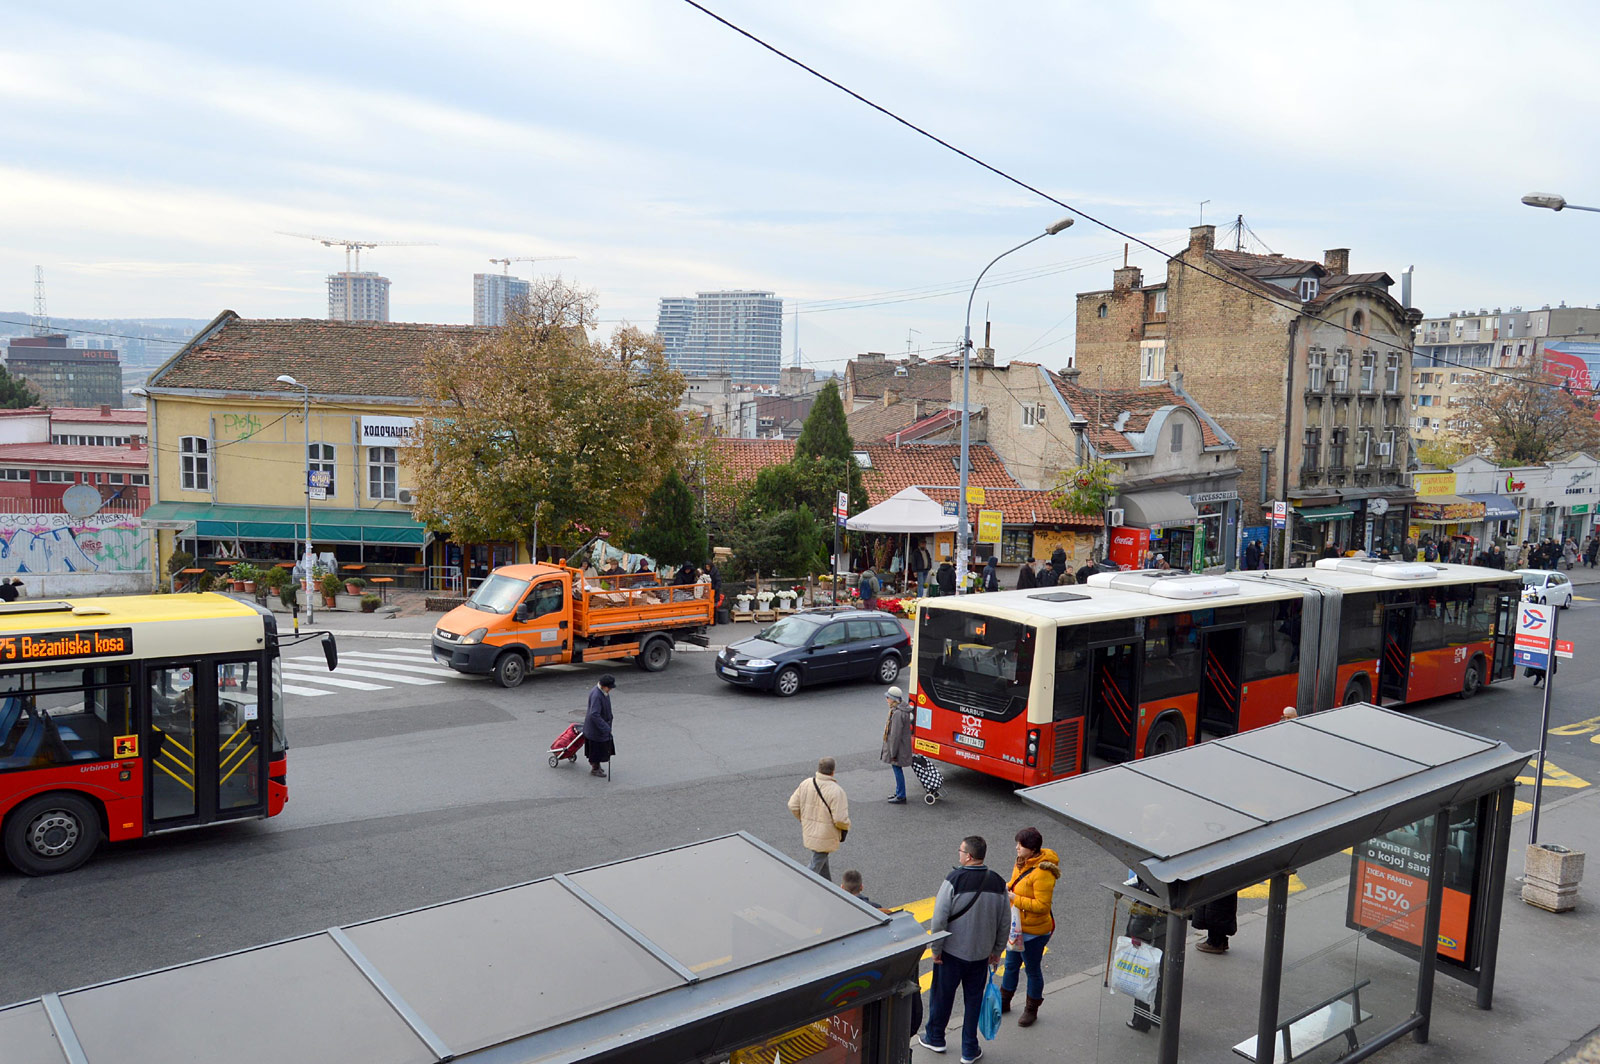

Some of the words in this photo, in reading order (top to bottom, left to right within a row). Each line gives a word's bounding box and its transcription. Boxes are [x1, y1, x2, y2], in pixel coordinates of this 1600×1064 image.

[82, 351, 116, 359] HOTEL
[22, 633, 91, 658] Bežanijska
[95, 632, 124, 653] kosa
[960, 706, 984, 717] IKARBUS
[963, 726, 978, 738] 3274
[1003, 754, 1024, 764] MAN
[80, 764, 109, 773] Urbino
[1413, 851, 1431, 862] sof
[1368, 849, 1375, 857] o
[1378, 851, 1404, 868] kojoj
[1407, 861, 1430, 876] sanj
[1366, 867, 1385, 878] IKEA
[1387, 874, 1413, 887] FAMILY
[1363, 882, 1410, 910] 15%
